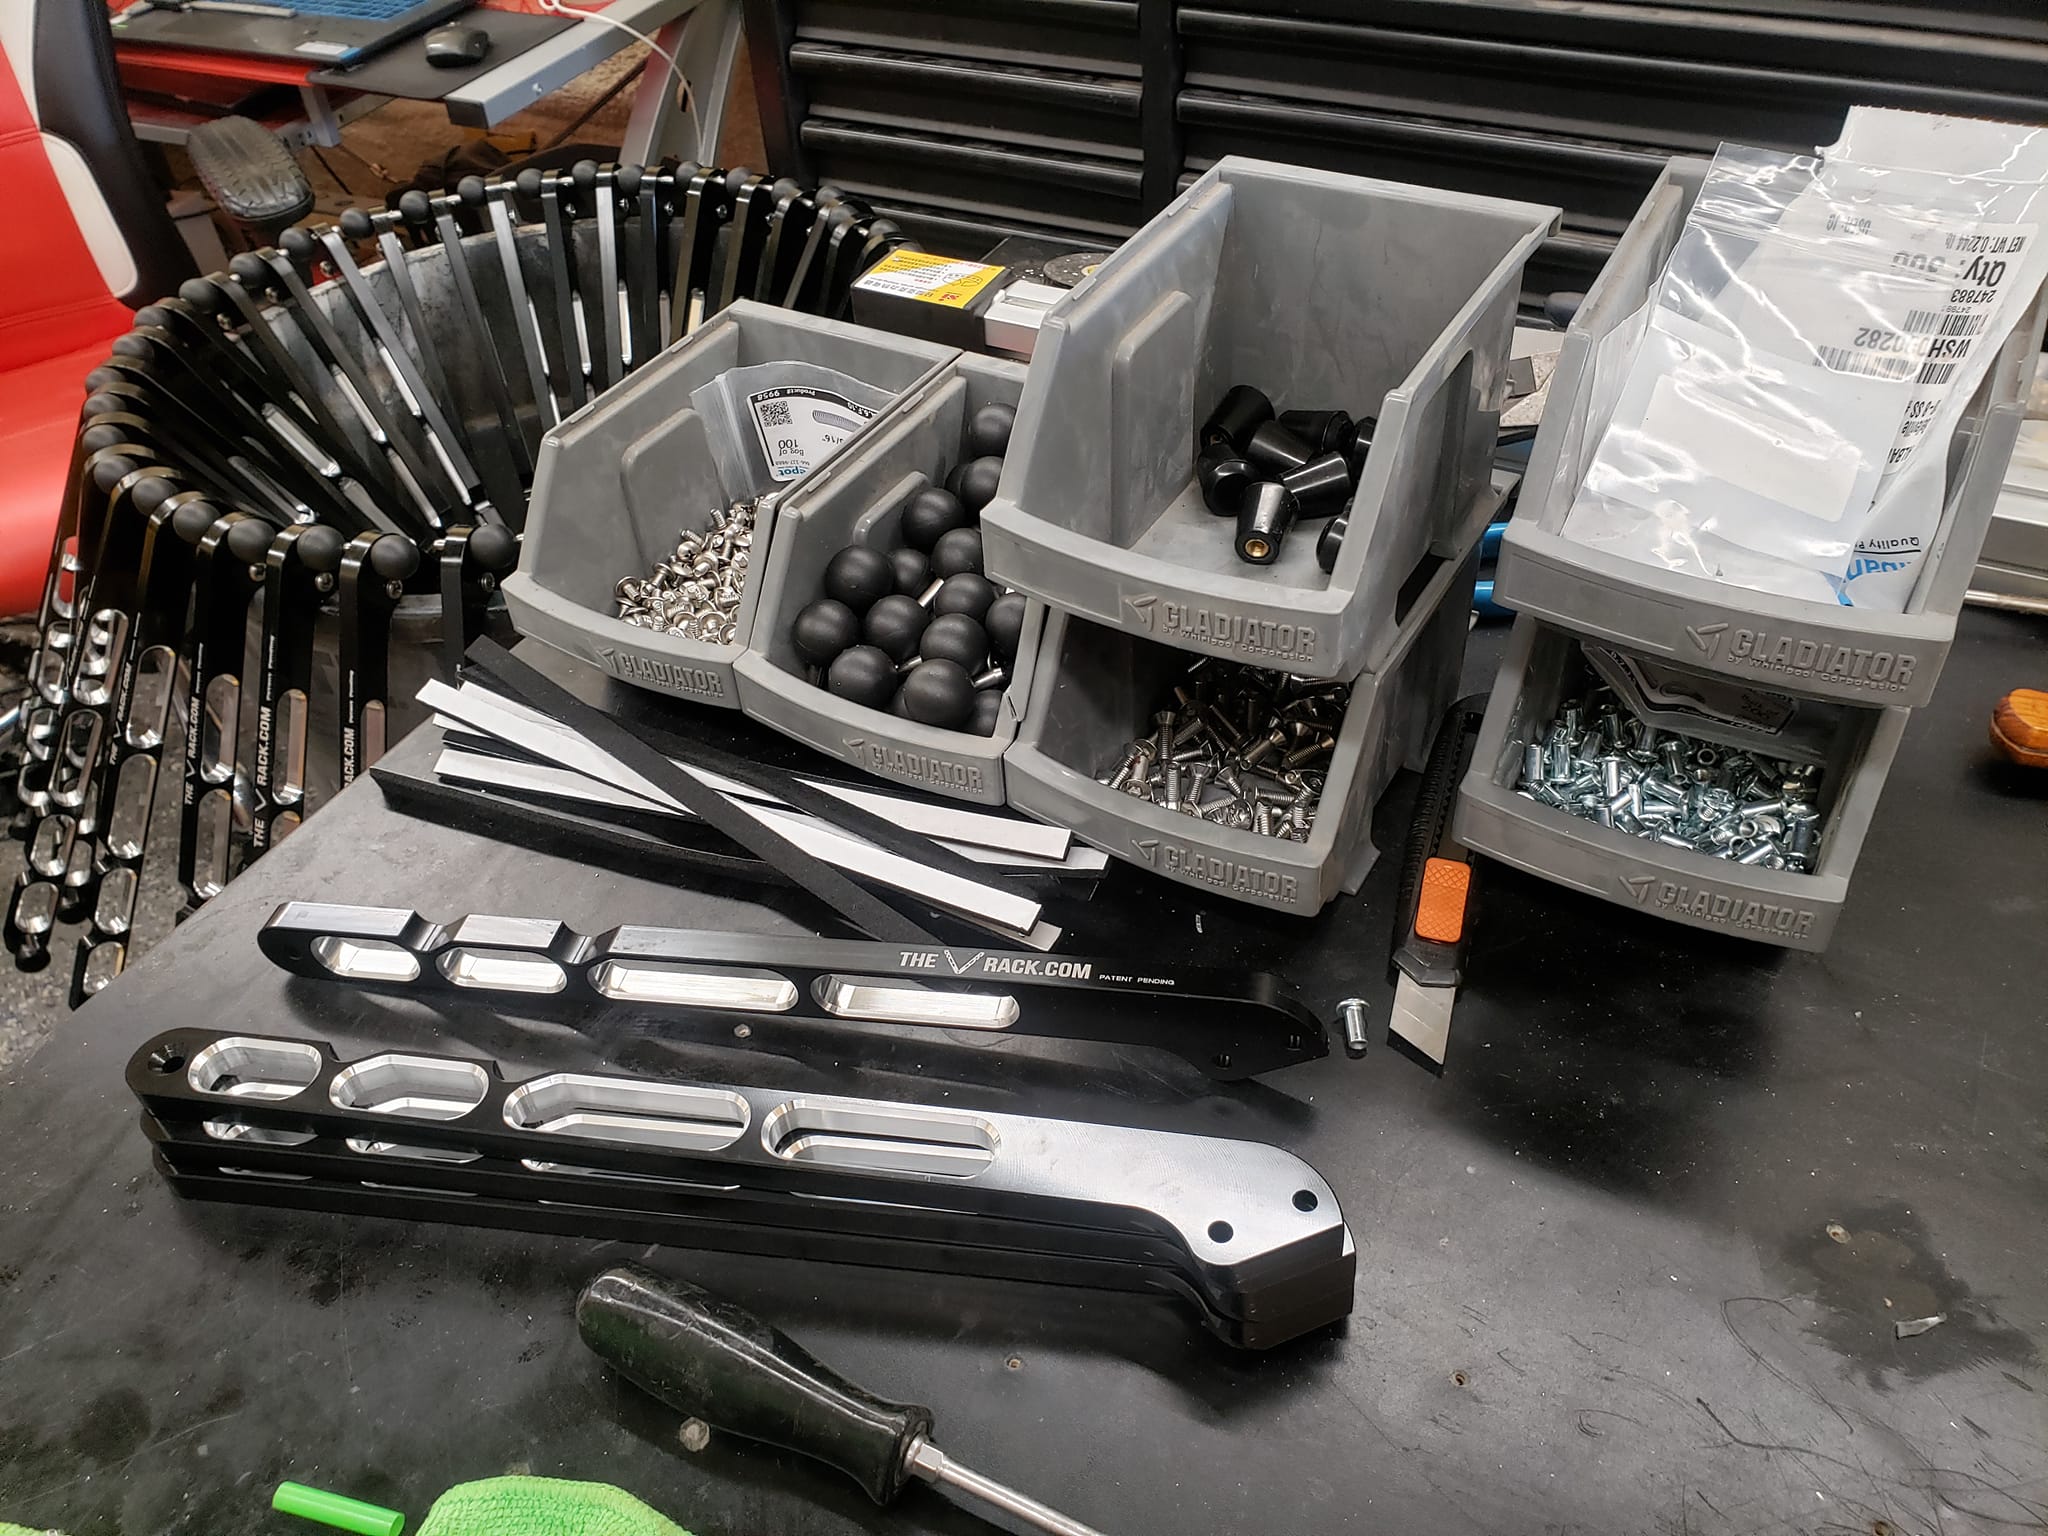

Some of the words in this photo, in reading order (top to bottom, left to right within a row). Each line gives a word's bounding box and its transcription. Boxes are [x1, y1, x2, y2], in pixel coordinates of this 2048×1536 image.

[1950, 289, 1997, 303] 247883
[1869, 536, 1920, 549] Quality
[1162, 601, 1316, 655] GLADIATOR
[619, 652, 723, 692] GLADIATOR
[1730, 628, 1917, 685] GLADIATOR
[257, 705, 272, 787] RACK.COM
[869, 742, 983, 789] GLADIATOR
[253, 817, 265, 849] THE
[1163, 845, 1299, 898] GLADIATOR
[1656, 882, 1816, 934] GLADIATOR
[899, 951, 940, 969] THE
[983, 957, 1093, 980] RACK.COM
[1099, 973, 1134, 983] PATENT
[1137, 976, 1176, 986] PENDING
